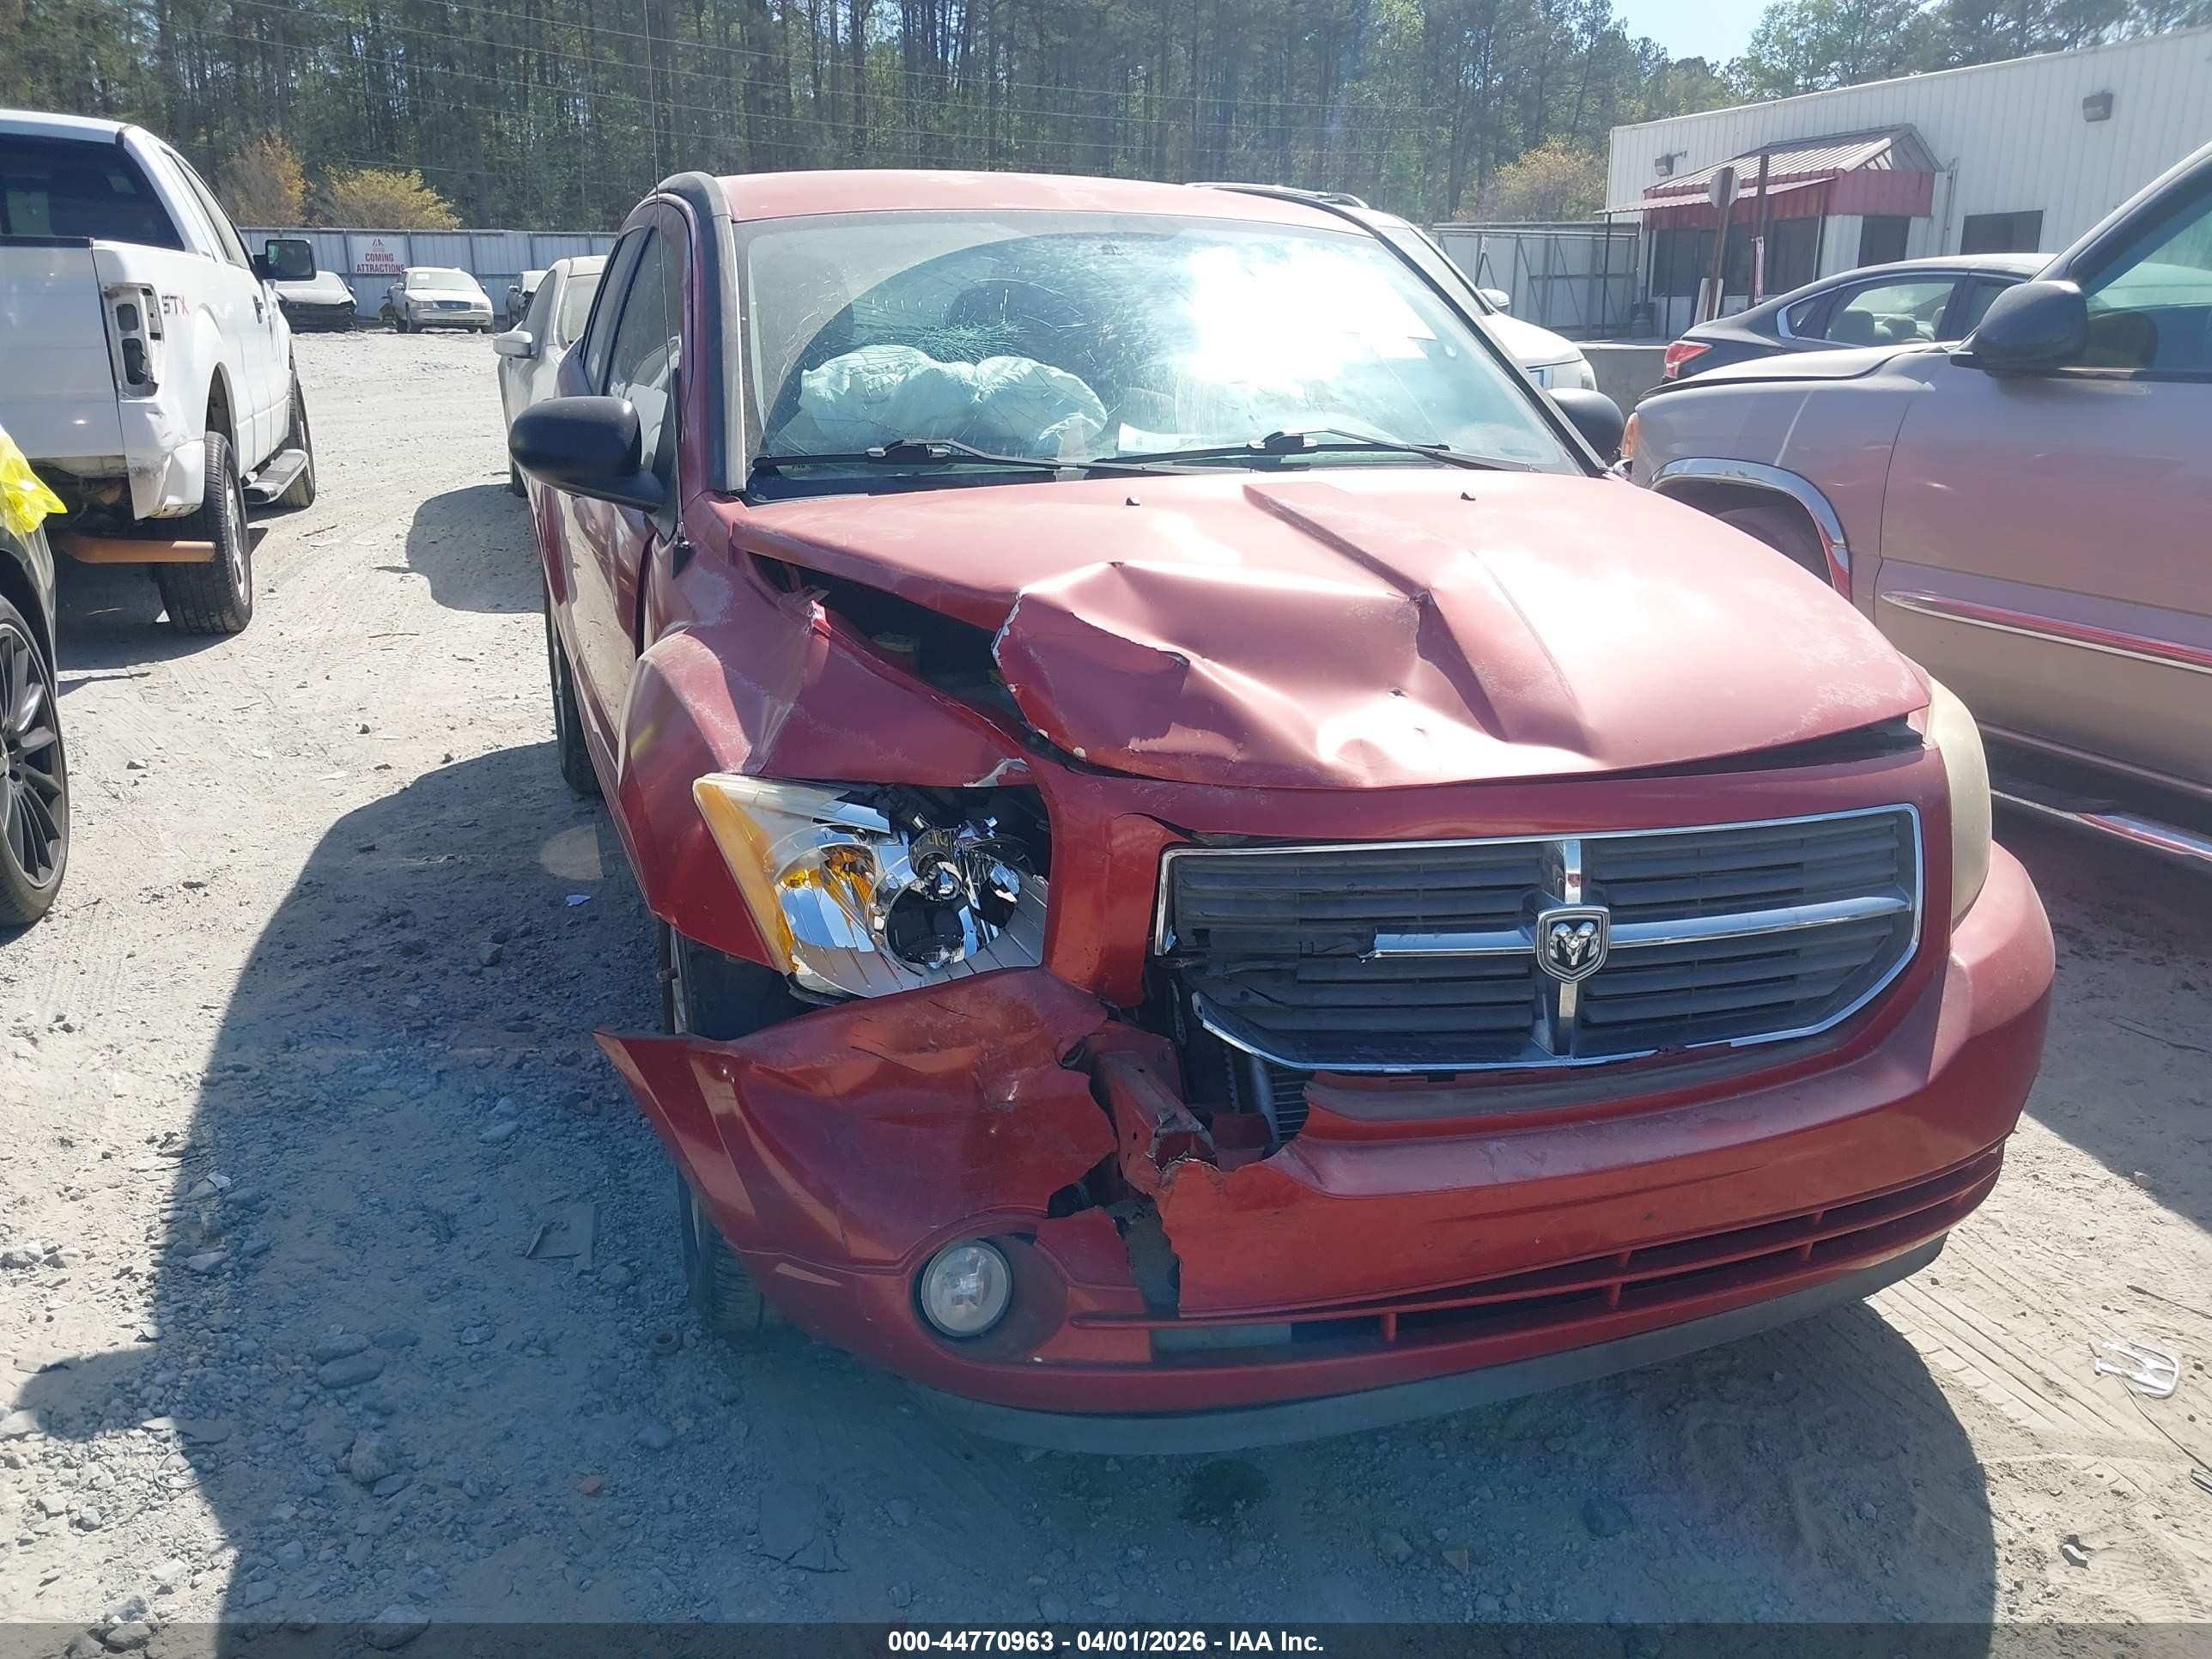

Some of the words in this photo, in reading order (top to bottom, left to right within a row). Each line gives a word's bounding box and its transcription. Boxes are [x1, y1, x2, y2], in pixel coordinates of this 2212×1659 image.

[365, 252, 394, 262] COMING
[356, 264, 405, 273] ATTRACTIONS
[161, 295, 190, 316] STX
